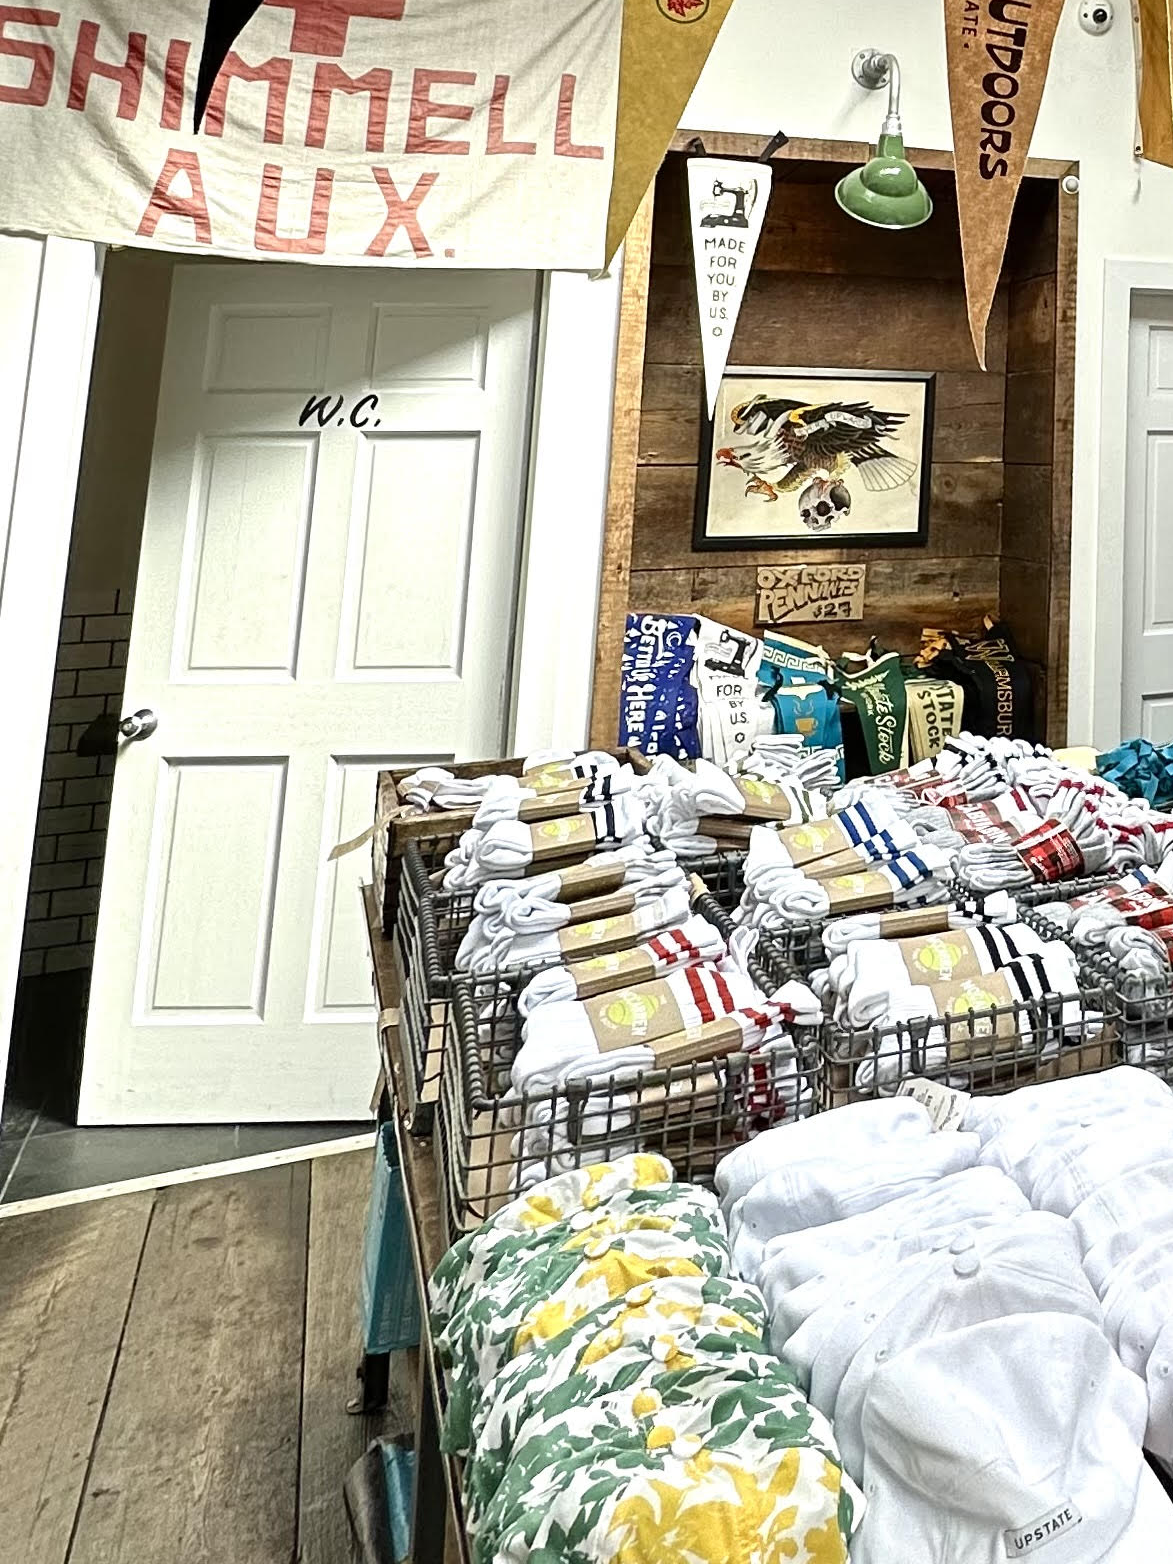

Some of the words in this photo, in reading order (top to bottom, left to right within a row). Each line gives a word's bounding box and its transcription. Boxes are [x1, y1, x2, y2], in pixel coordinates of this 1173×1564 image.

[0, 5, 605, 159] SHIMMELL
[136, 148, 456, 258] AUX.
[704, 239, 746, 254] MADE
[710, 256, 737, 269] FOR
[713, 290, 728, 302] BY
[300, 395, 381, 428] W.C.
[757, 567, 865, 589] OXFORD
[760, 581, 859, 620] PENNANTS
[716, 685, 743, 697] FOR
[917, 690, 940, 748] STOCK
[1014, 1508, 1074, 1550] UPSTATE
